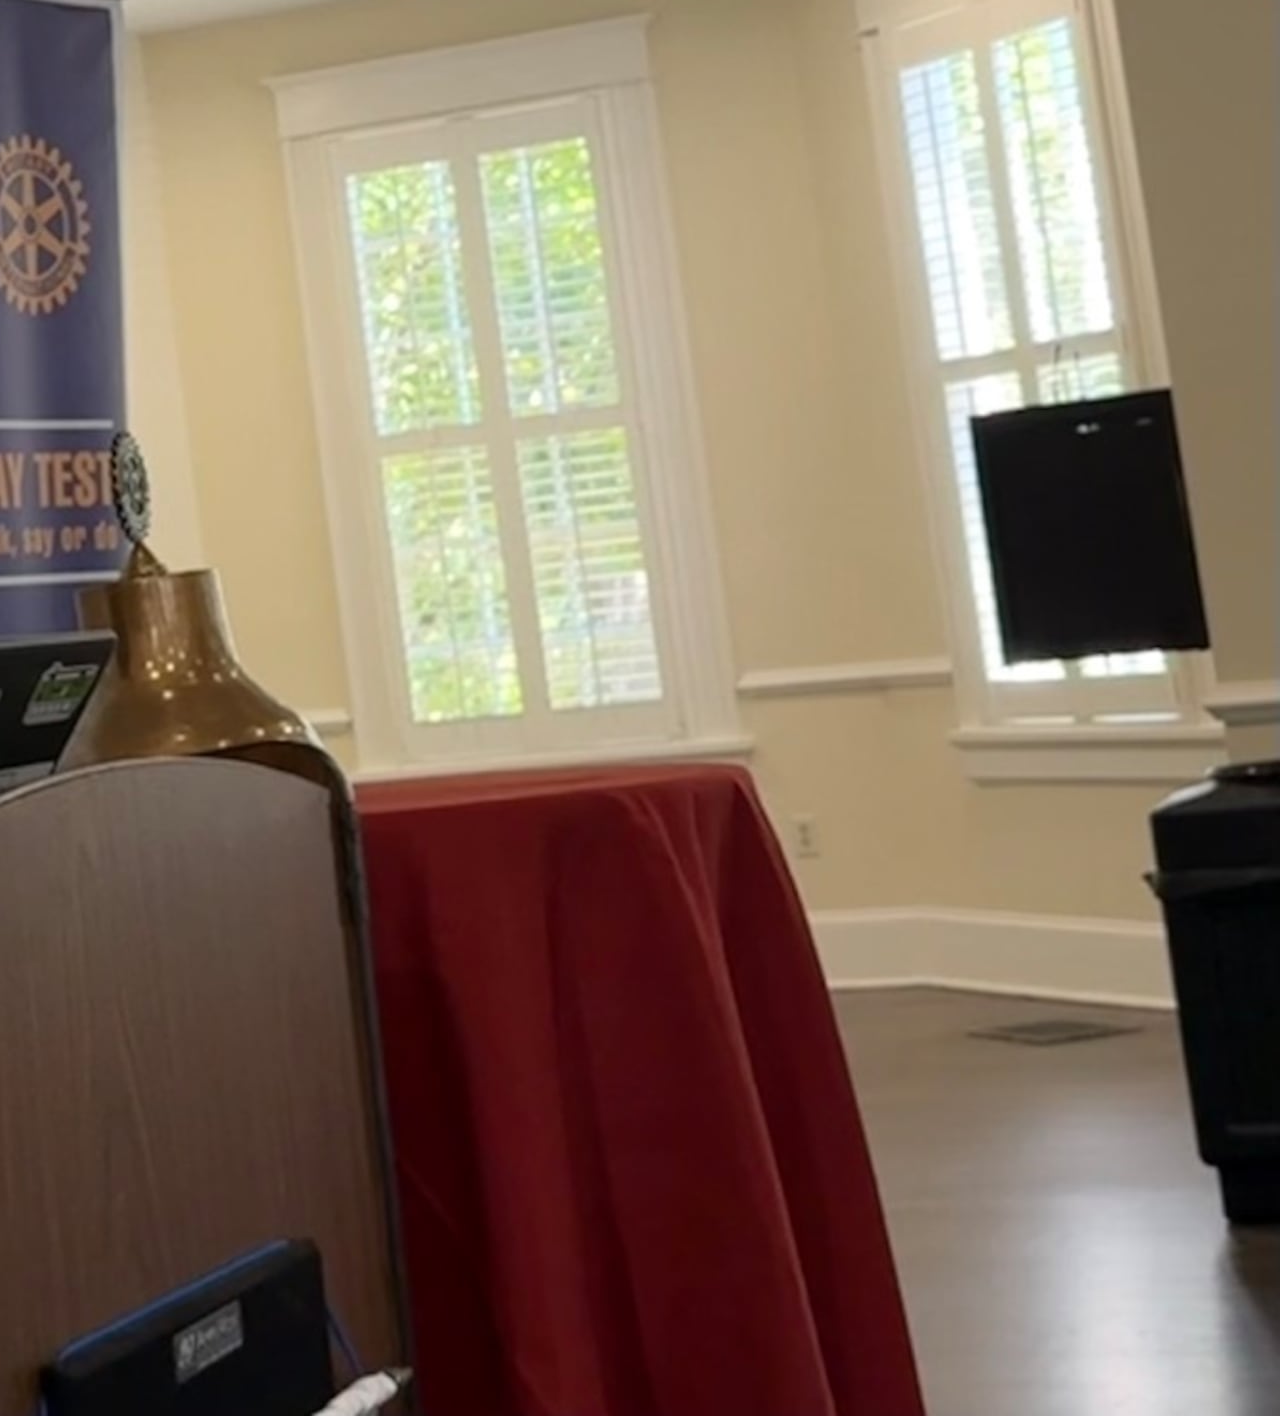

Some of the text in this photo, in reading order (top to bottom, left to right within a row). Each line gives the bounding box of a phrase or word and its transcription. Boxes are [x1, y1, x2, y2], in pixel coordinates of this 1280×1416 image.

[34, 451, 114, 508] TEST
[23, 528, 53, 558] say
[61, 526, 86, 551] or
[94, 521, 117, 551] do
